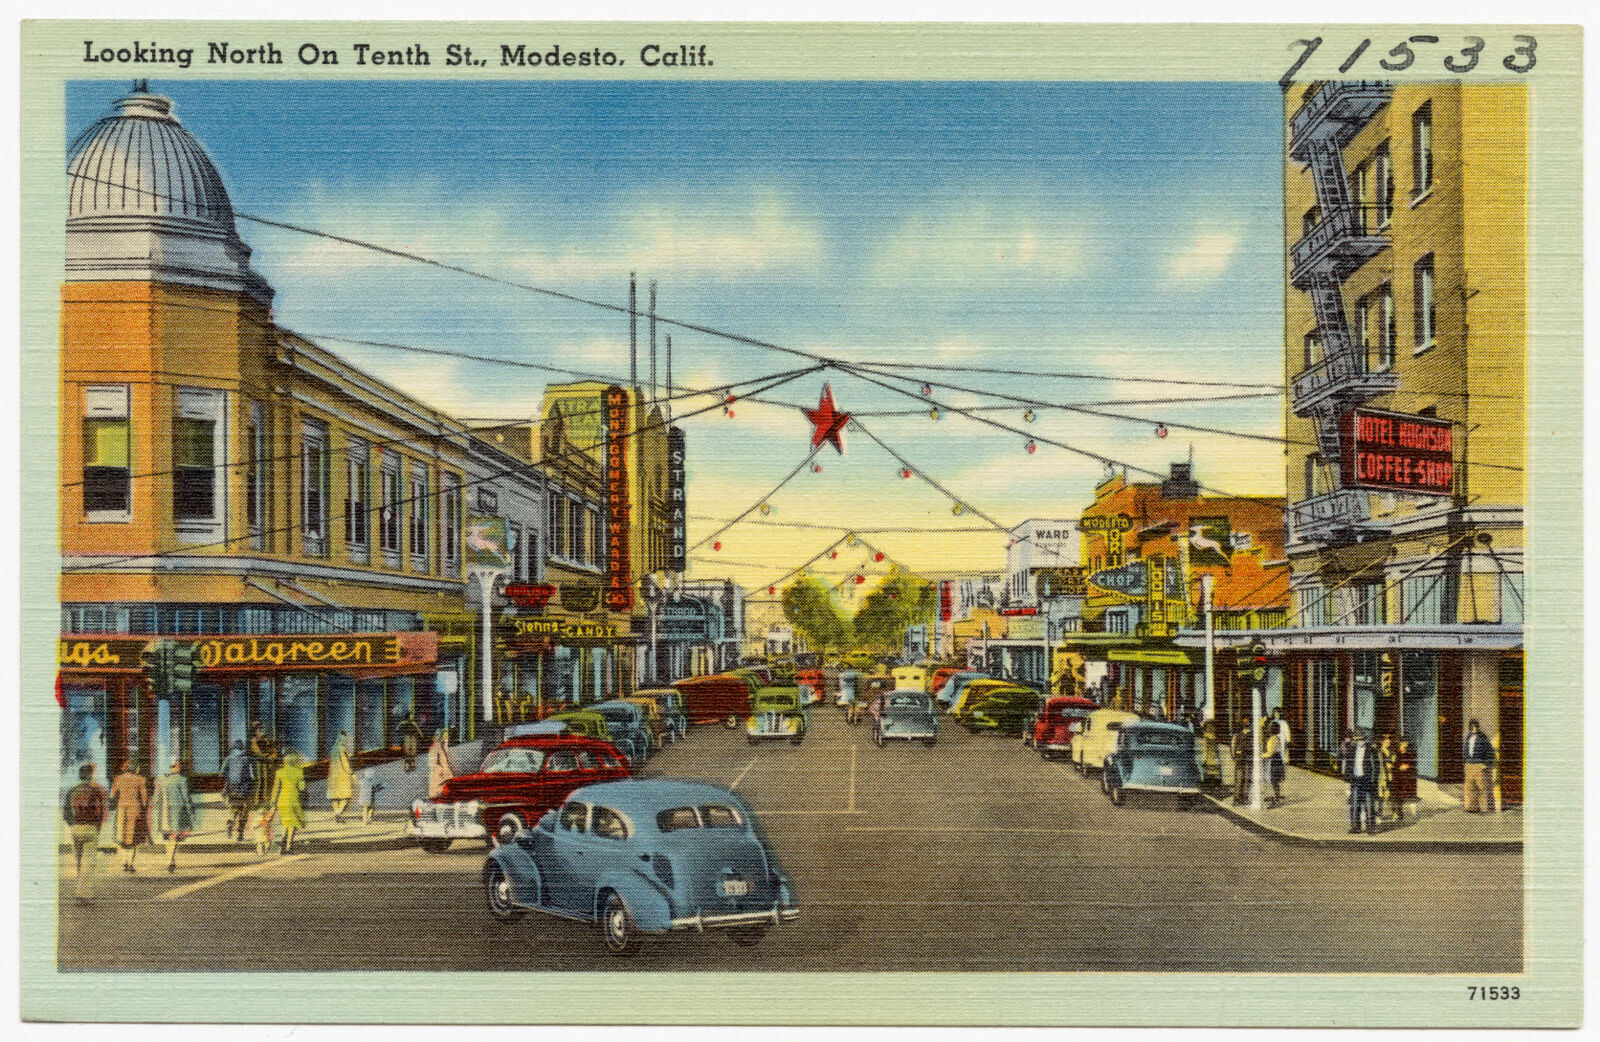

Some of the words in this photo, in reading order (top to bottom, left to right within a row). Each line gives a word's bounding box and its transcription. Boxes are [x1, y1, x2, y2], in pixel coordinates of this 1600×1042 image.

[1279, 35, 1538, 85] 71533
[1358, 415, 1396, 446] HOTEL
[1358, 452, 1411, 484] COFFEE
[1415, 459, 1453, 489] SHOP
[672, 450, 684, 558] STRAND
[1035, 529, 1070, 540] WARD
[1097, 574, 1134, 587] CHOP
